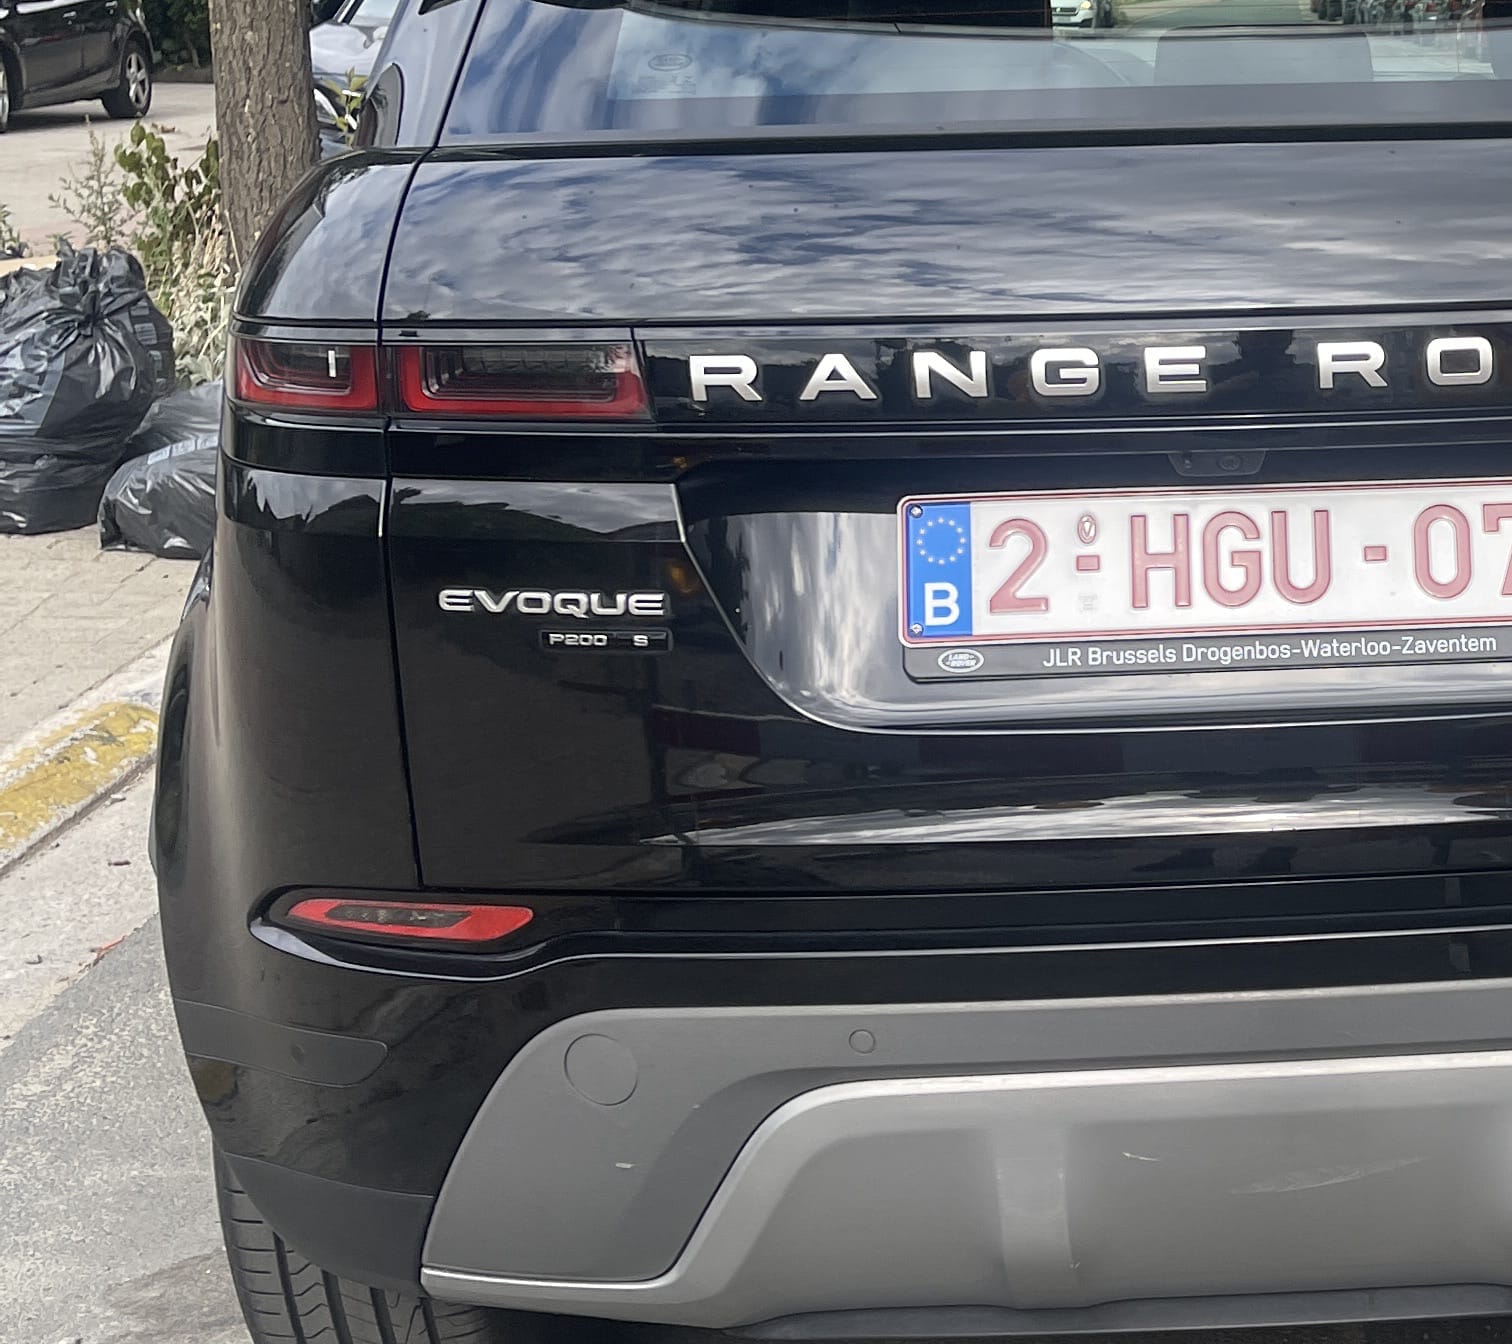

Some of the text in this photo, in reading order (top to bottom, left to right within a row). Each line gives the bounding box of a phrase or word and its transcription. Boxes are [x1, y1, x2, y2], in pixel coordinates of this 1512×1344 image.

[689, 345, 1207, 402] RANGE
[438, 589, 665, 619] EVOQUE
[923, 584, 960, 627] B
[549, 634, 649, 646] P200 S
[1042, 636, 1497, 667] JLR Brussels Drogenbos-Waterloo-Zaventem
